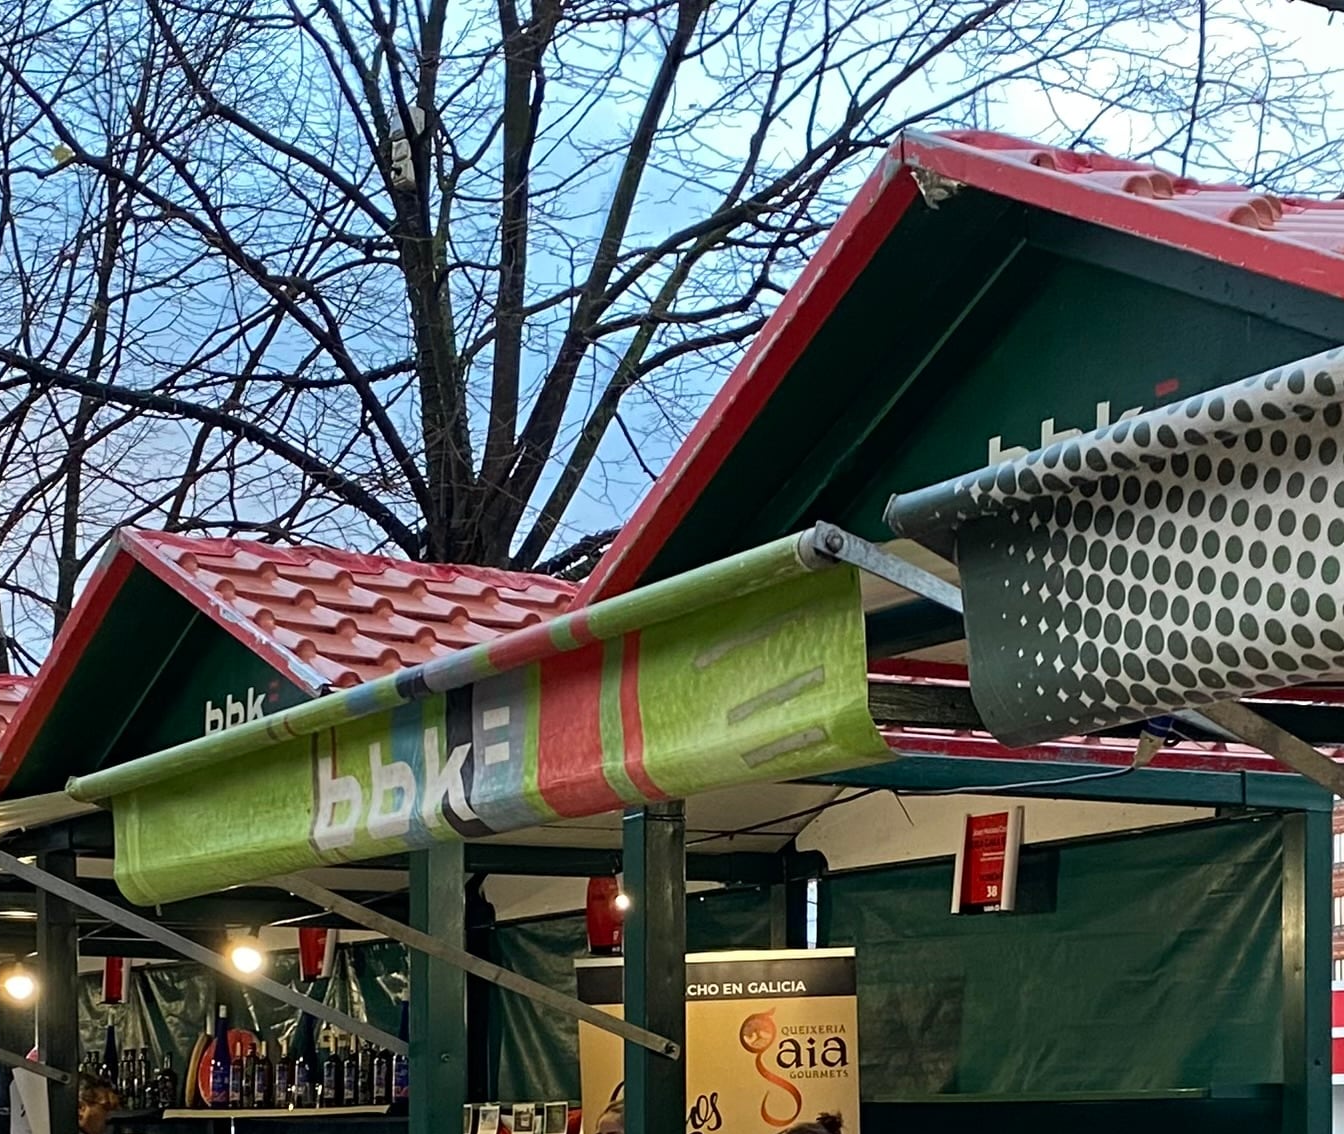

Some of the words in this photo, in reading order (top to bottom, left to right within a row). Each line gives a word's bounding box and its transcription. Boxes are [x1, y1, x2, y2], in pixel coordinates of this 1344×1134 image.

[314, 727, 480, 851] bbk
[686, 984, 719, 996] CHO
[723, 983, 742, 995] EN
[747, 981, 806, 994] GALICIA
[781, 1024, 846, 1036] QUEIXERIA
[789, 1069, 849, 1080] GOURMETS
[686, 1092, 722, 1131] os
